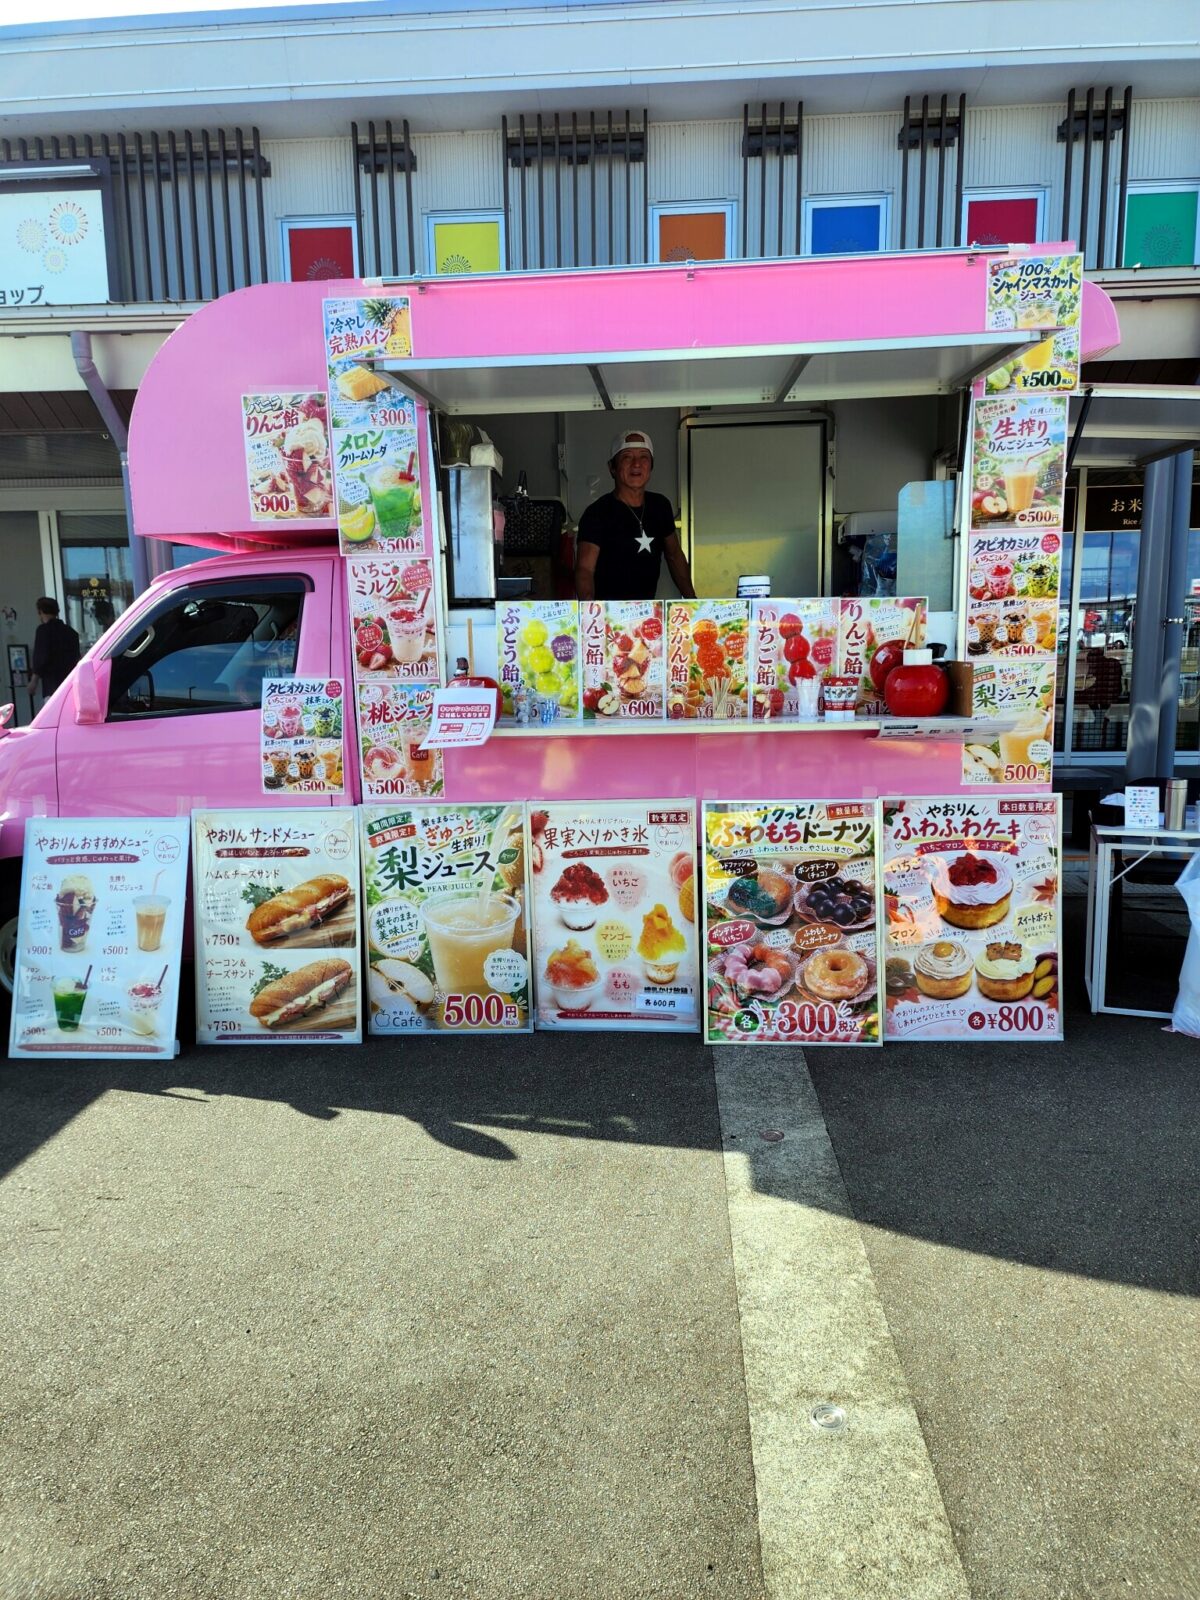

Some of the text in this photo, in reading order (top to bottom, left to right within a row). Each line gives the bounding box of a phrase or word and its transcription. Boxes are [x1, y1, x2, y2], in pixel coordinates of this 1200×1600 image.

[1019, 264, 1052, 277] 100%
[992, 272, 1079, 295] シャインマスカット
[1020, 289, 1052, 301] ジュース
[330, 316, 366, 334] 冷やし
[329, 329, 390, 357] 完熟パイン
[1022, 370, 1062, 387] ¥500
[246, 395, 283, 416] バニラ
[246, 408, 299, 437] りんご飴
[370, 408, 406, 427] ¥300
[993, 416, 1048, 441] 生搾り
[336, 430, 384, 456] メロン
[988, 437, 1052, 453] りんごジュース
[340, 444, 388, 469] クリームソーダ
[254, 494, 290, 513] ¥900
[1110, 498, 1142, 513] お米
[1027, 510, 1059, 522] 500円
[1123, 518, 1138, 526] Rice
[378, 537, 414, 554] ¥500
[973, 537, 1040, 556] タピオカミルク
[975, 554, 1009, 564] いちごミルク
[1017, 552, 1050, 563] 抹茶ミルク
[352, 560, 395, 578] いちご
[355, 578, 398, 596] ミルク
[586, 602, 605, 666] りんご飴
[844, 603, 865, 675] りんご飴
[502, 607, 520, 683] ぶどう飴
[671, 607, 690, 683] みかん飴
[757, 609, 777, 686] いちご飴
[1004, 645, 1036, 657] ¥500
[394, 662, 429, 677] ¥500
[591, 666, 599, 688] (カット)
[266, 681, 325, 698] タピオカミルク
[416, 691, 434, 704] 100
[974, 683, 1039, 709] 梨ジュース
[267, 696, 297, 705] いちごミルク
[305, 696, 334, 706] 抹茶ミルク
[622, 701, 655, 716] ¥600
[367, 701, 433, 726] 桃ジュース
[697, 702, 736, 718] ¥60
[411, 751, 427, 759] Café
[1004, 764, 1044, 781] 500円
[297, 780, 326, 792] ¥500
[367, 779, 405, 795] ¥500
[754, 805, 815, 823] サクっと!
[926, 803, 980, 818] やおりん
[1001, 801, 1055, 812] 本日数量限定
[371, 814, 407, 831] 期間限定!
[421, 814, 461, 828] 梨をまるごと
[651, 813, 687, 823] 数量限定
[206, 827, 315, 845] やおりん サンドメニュー
[375, 826, 411, 846] 数量限定!
[426, 819, 475, 847] ぎゅっと
[544, 824, 649, 849] 果実入りかき氷
[712, 821, 872, 848] ふわもちドーナツ
[893, 816, 1021, 841] ふわふわケーキ
[36, 836, 148, 852] やおりん おすすめメニュー
[452, 834, 486, 854] 生搾り!
[377, 845, 496, 892] 梨ジュース
[891, 858, 921, 873] いちご
[206, 869, 280, 879] ハム&チーズサンド
[807, 870, 827, 880] (チョコ)
[109, 884, 143, 892] りんごジュース
[427, 883, 475, 894] PEAR JUICE
[613, 878, 640, 888] いちご
[376, 912, 418, 931] 梨そのままの
[1017, 912, 1053, 927] スイートポテト
[68, 928, 85, 936] Café
[379, 920, 419, 942] 美味しさ!
[601, 933, 632, 941] マンゴー
[721, 933, 744, 944] (いちご)
[803, 927, 826, 938] ふわもち
[890, 929, 917, 940] マロン
[205, 934, 235, 946] ¥750
[799, 933, 838, 946] シュガードーナツ
[27, 945, 48, 955] ¥900
[102, 945, 124, 955] ¥500
[206, 958, 246, 967] ベーコン&
[206, 969, 255, 980] チーズサンド
[613, 980, 630, 989] もも
[444, 994, 517, 1026] 500円
[741, 1001, 859, 1034] 各 ¥300 税込
[896, 1002, 951, 1018] やおりんのスイーツで
[207, 1020, 236, 1032] ¥750
[392, 1016, 423, 1028] Café
[897, 1009, 957, 1029] しあわせなひとときを
[972, 1005, 1056, 1032] 各 ¥800 税込
[96, 1027, 117, 1037] ¥500
